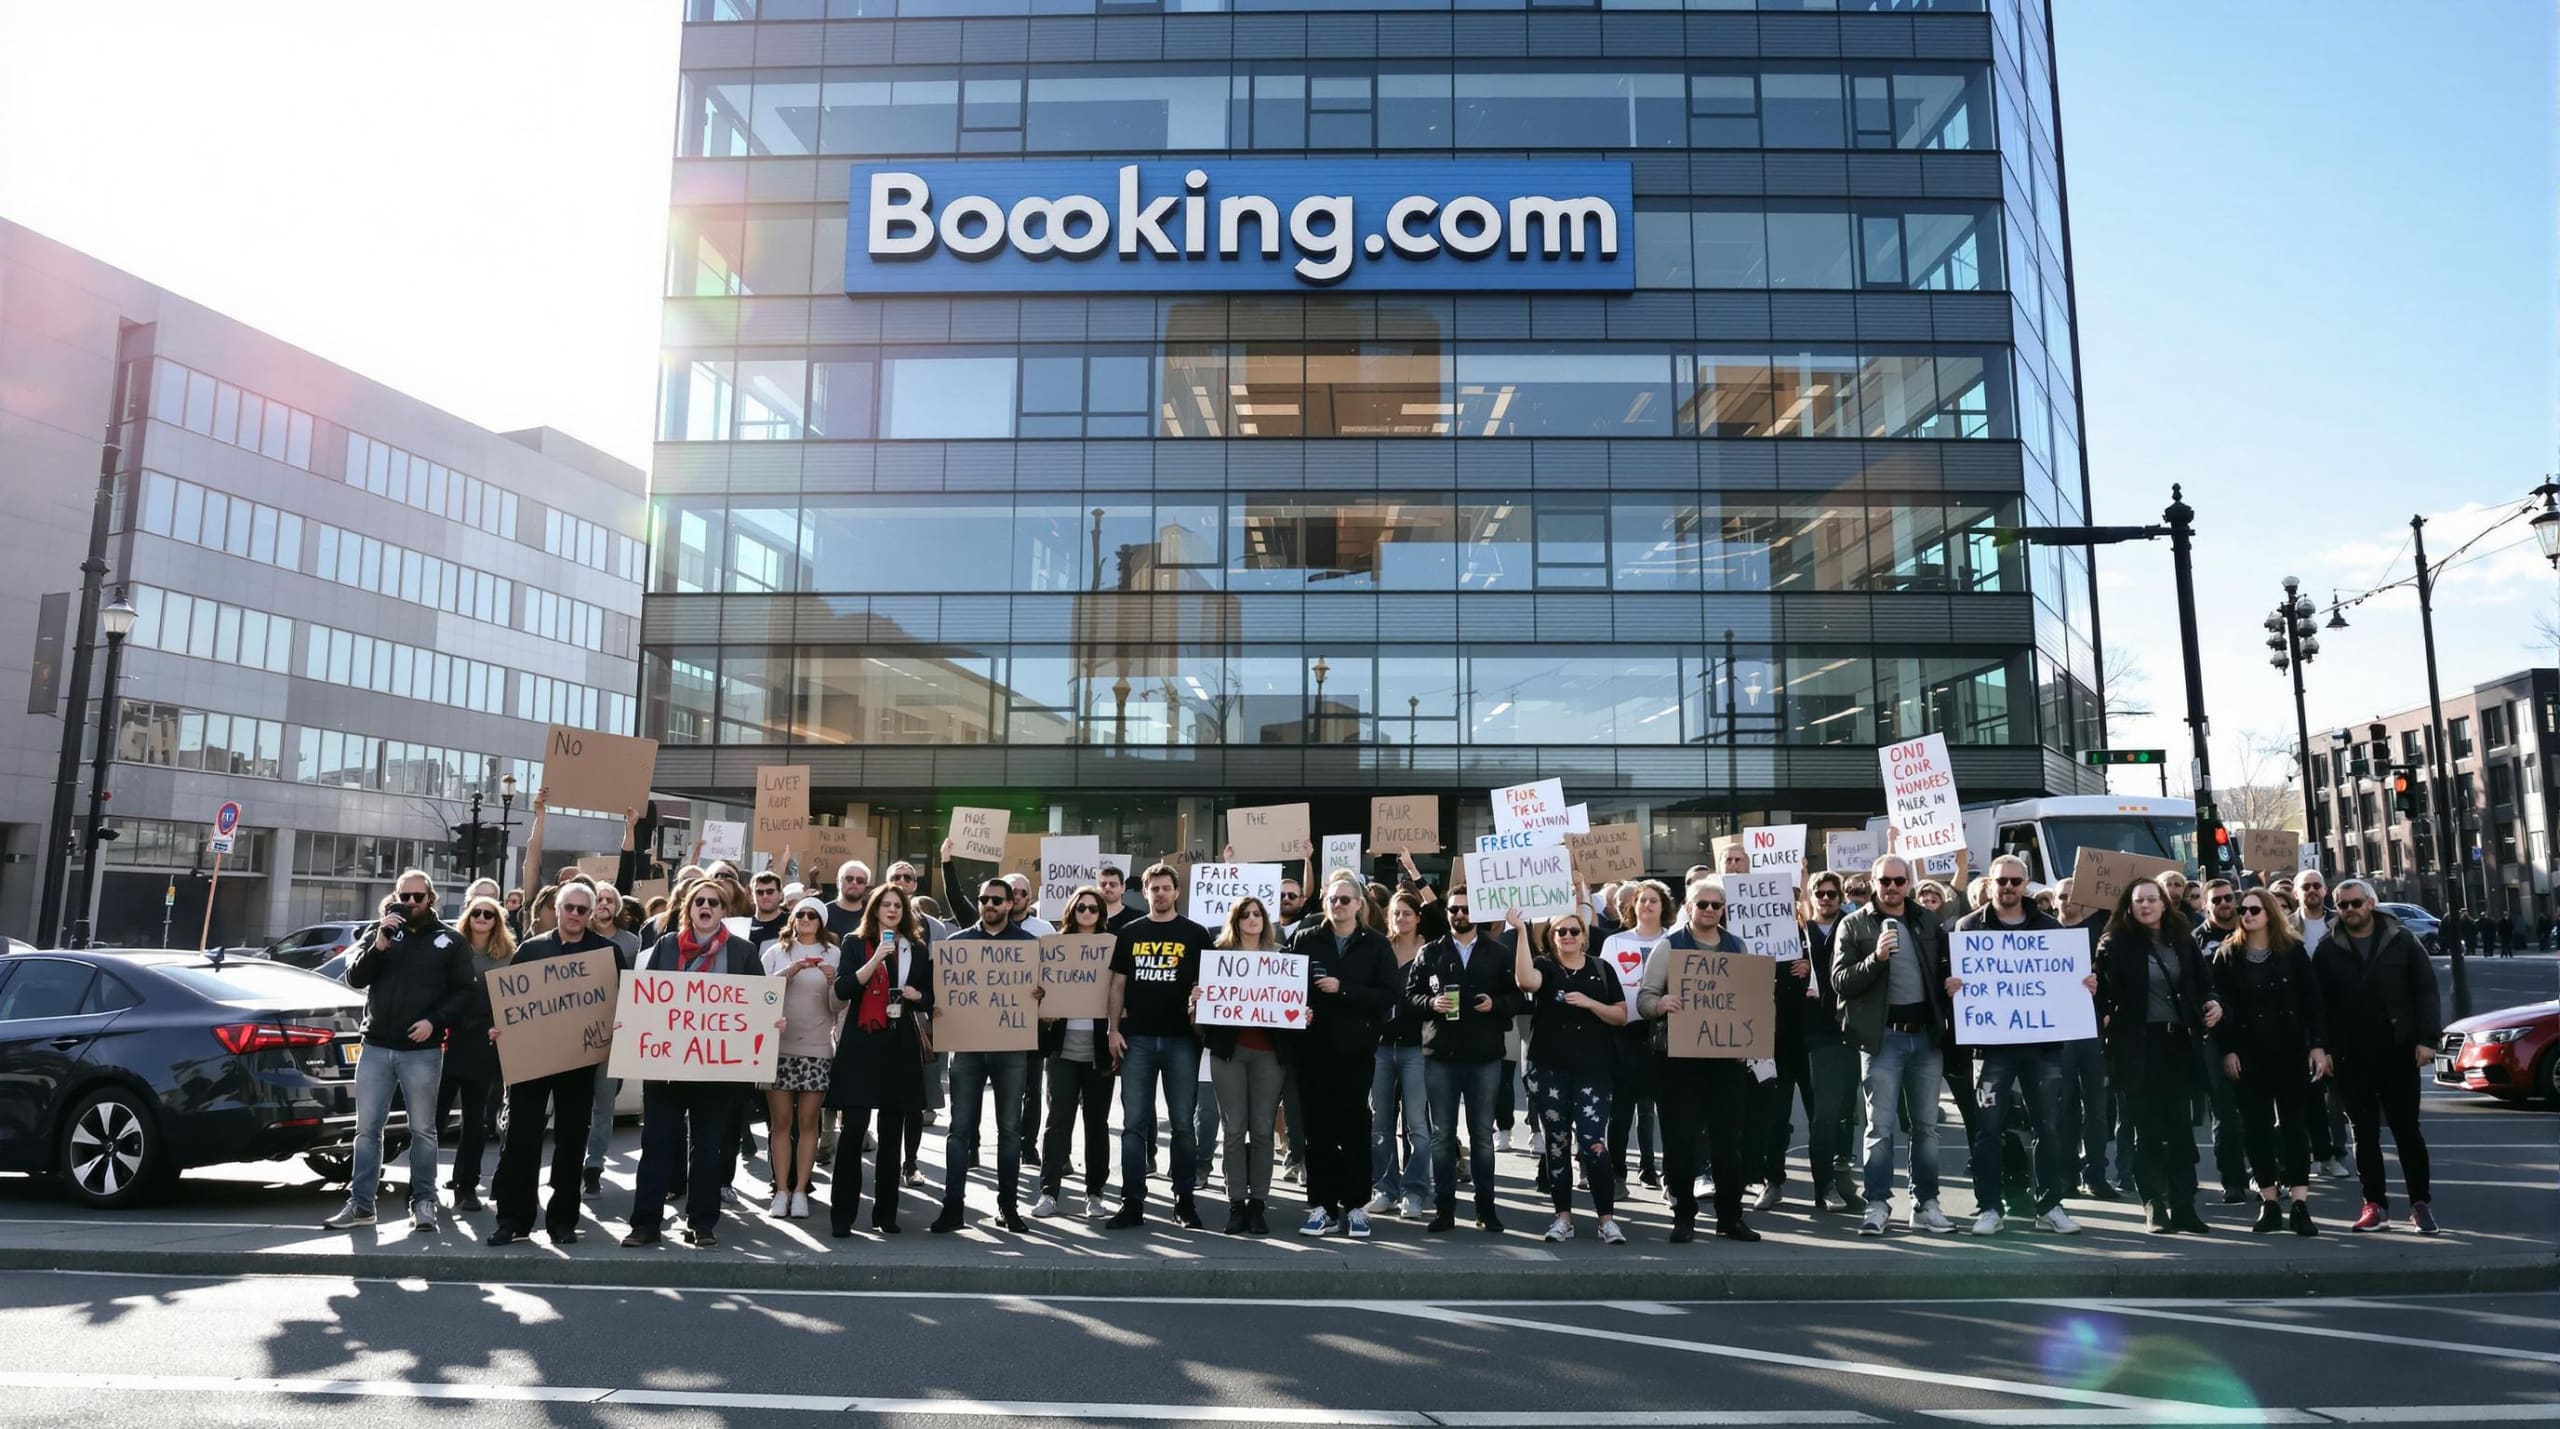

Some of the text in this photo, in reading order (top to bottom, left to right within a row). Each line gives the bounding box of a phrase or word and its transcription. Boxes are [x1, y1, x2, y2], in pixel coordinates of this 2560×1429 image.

[1755, 831, 1775, 848] NO
[1048, 863, 1097, 881] BOOKING
[1201, 865, 1239, 880] FAIR
[1196, 881, 1250, 898] PRICES
[1742, 923, 1772, 939] LAT
[1966, 933, 2050, 951] NO MORE
[939, 945, 1025, 965] NO MORE
[1217, 955, 1300, 978] NO MORE
[1683, 954, 1729, 977] FAIR
[498, 961, 591, 998] NO MORE
[943, 969, 977, 987] FAIR
[634, 977, 750, 1005] NO MORE
[948, 990, 1019, 1008] FOR ALL
[1962, 982, 1989, 998] FOR
[668, 1008, 748, 1032] PRICES
[1213, 1005, 1279, 1023] FOR ALL
[1965, 1006, 2056, 1030] FOR ALL
